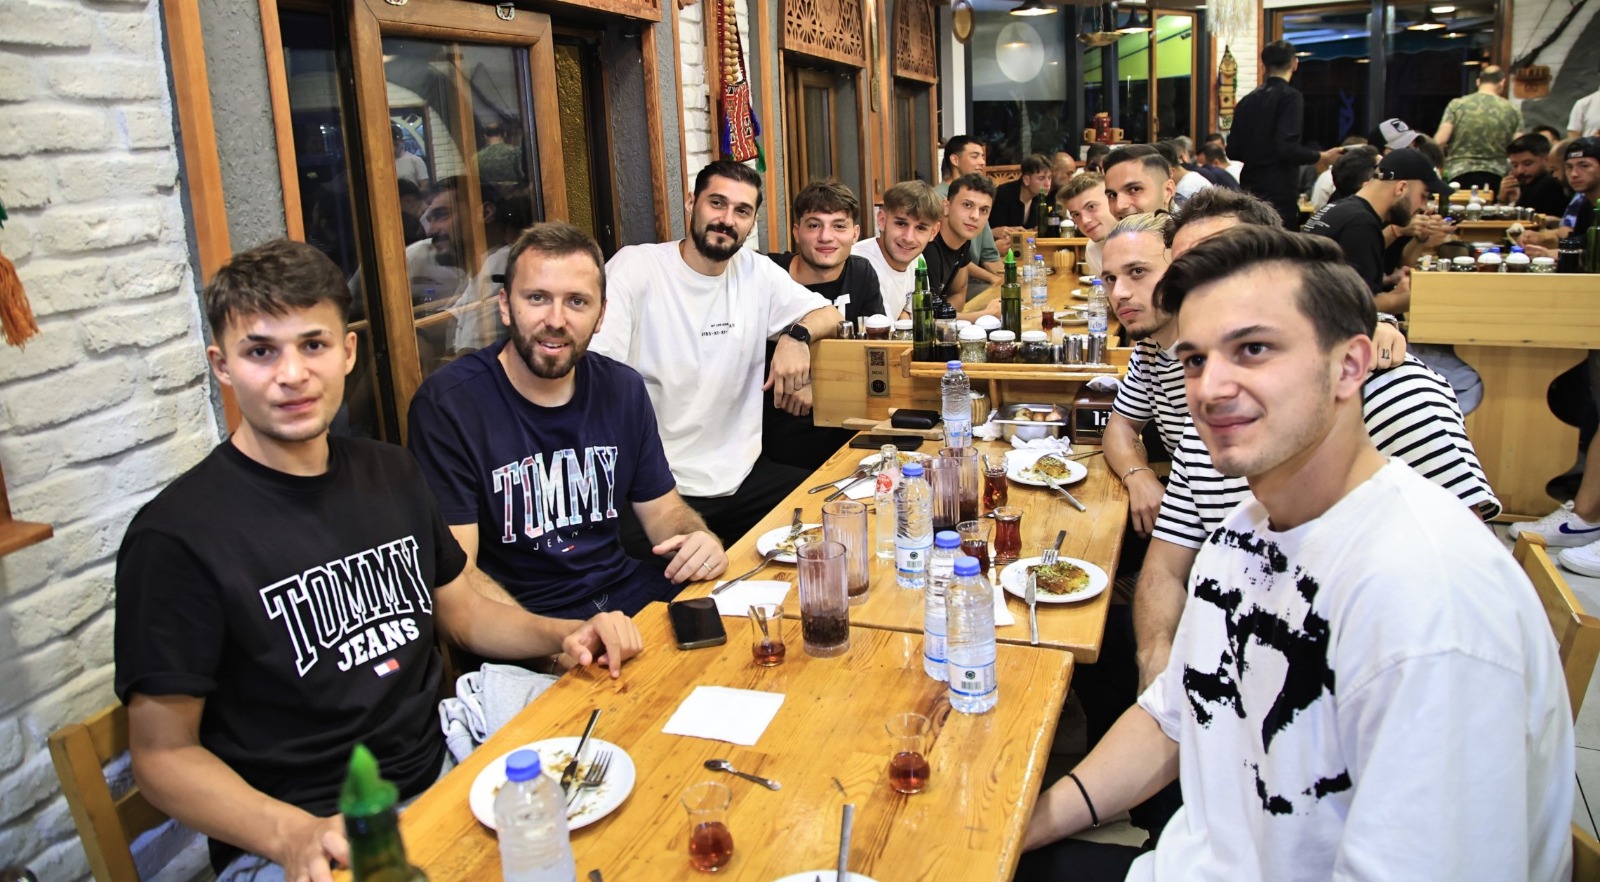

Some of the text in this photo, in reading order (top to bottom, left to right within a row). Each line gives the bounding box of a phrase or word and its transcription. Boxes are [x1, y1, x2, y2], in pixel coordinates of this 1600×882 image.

[492, 446, 618, 543] TOMMY
[259, 535, 432, 677] TOMMY
[337, 618, 420, 672] JEANS
